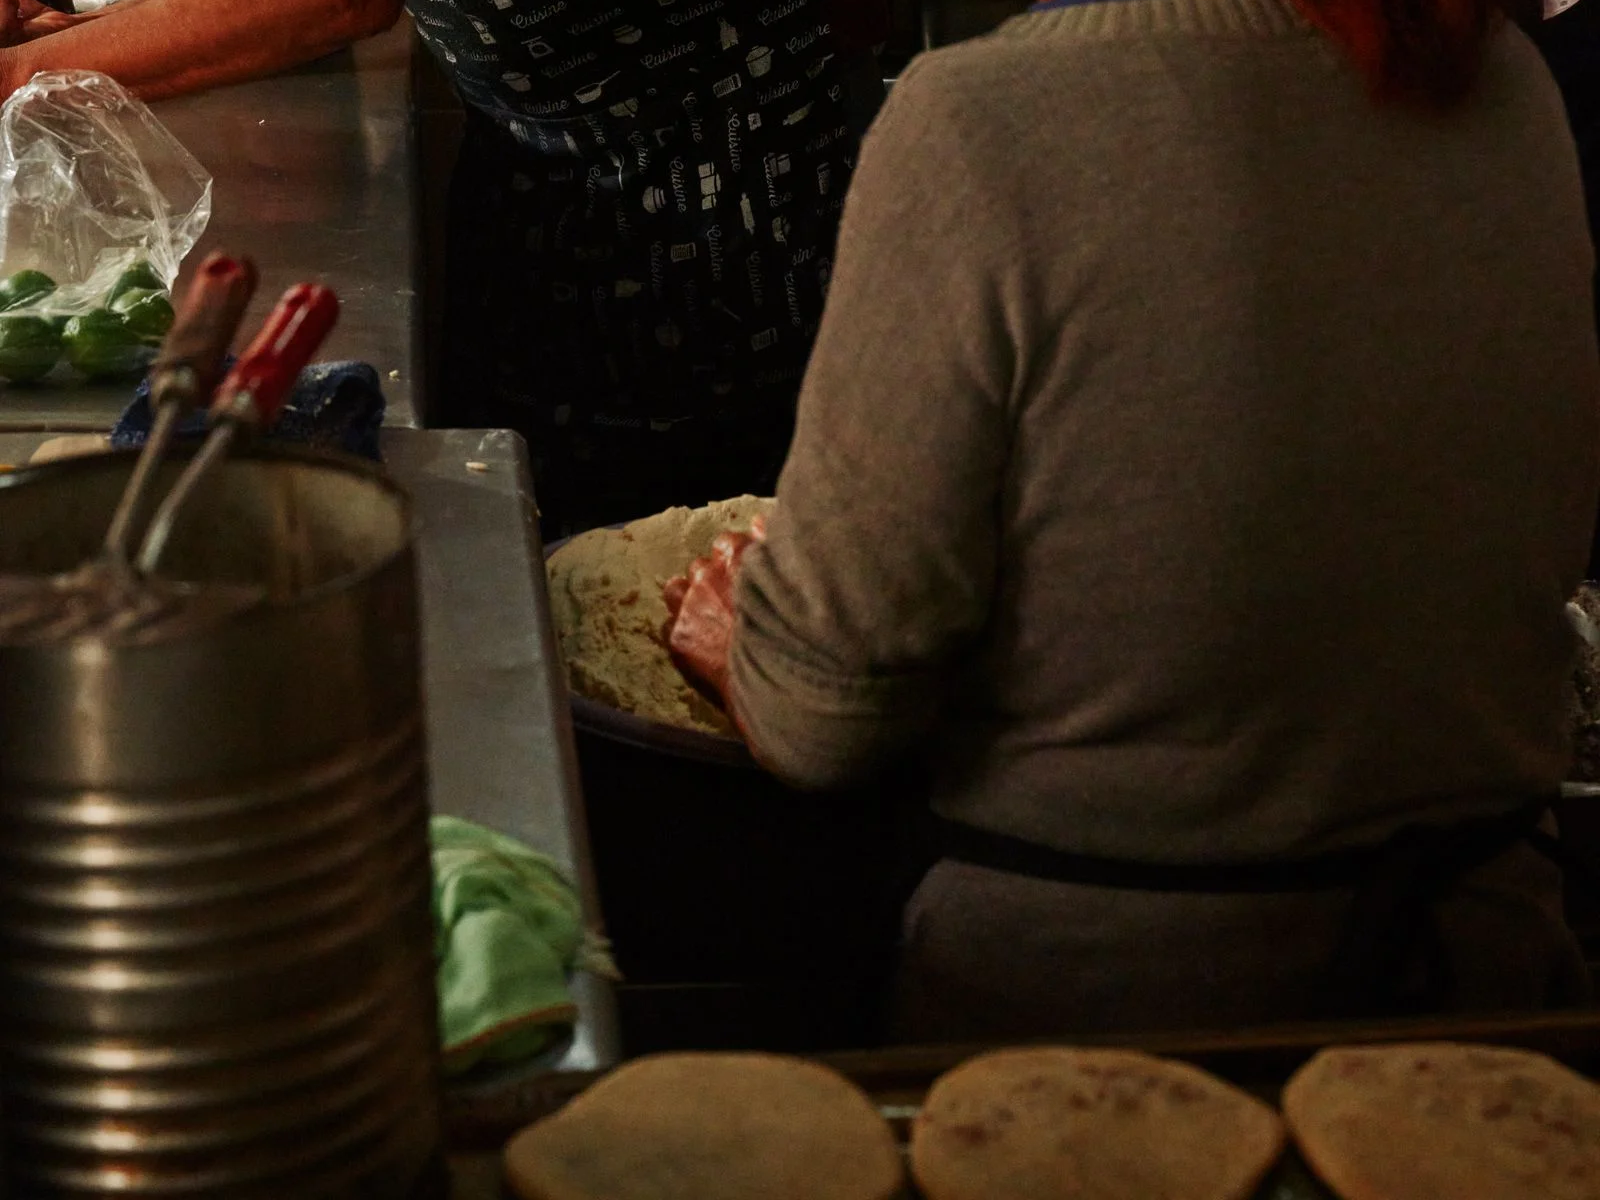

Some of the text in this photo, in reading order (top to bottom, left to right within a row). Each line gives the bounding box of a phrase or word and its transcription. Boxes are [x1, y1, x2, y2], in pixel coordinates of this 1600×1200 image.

[510, 0, 568, 29] Cuisine
[569, 7, 624, 36] Cuisine
[640, 40, 698, 69] Cuisine
[727, 104, 743, 174] Cuisine
[669, 156, 688, 215] Cuisine
